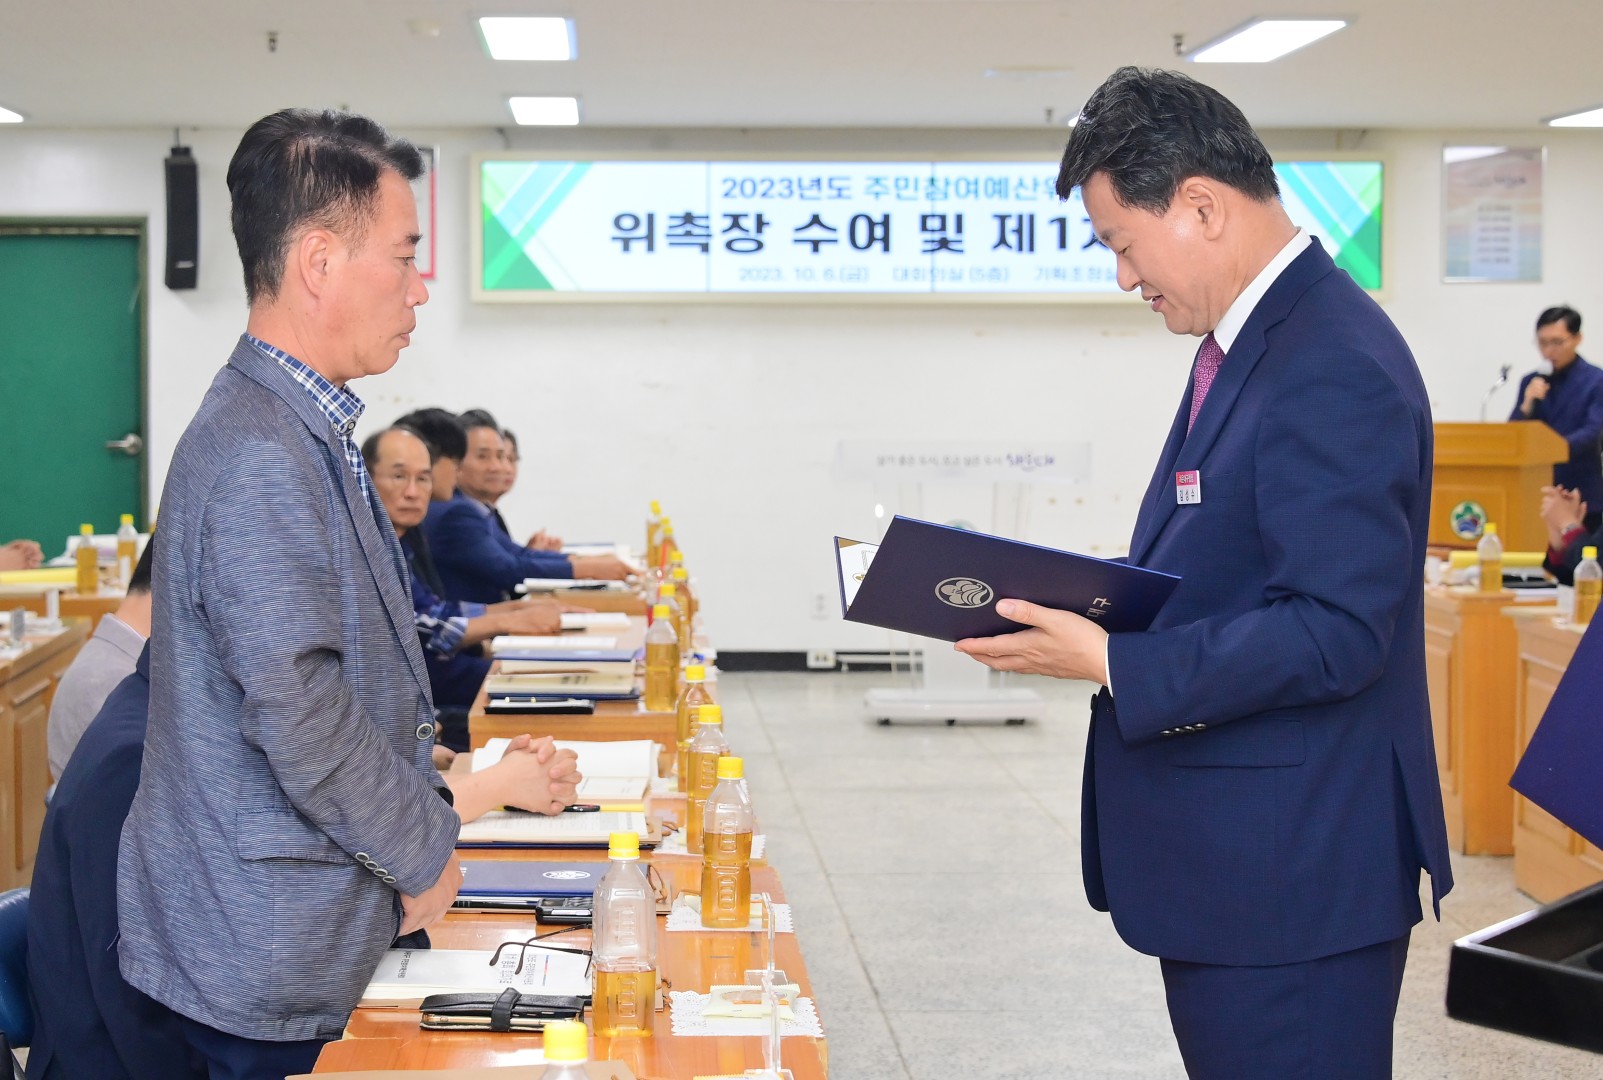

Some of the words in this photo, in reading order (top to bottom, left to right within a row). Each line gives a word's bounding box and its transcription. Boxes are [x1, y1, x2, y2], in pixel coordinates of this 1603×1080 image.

[722, 176, 852, 201] 2023년도
[864, 176, 1081, 201] 주민참여예산
[611, 211, 770, 253] 위촉장
[793, 212, 891, 253] 수여
[920, 212, 965, 253] 및
